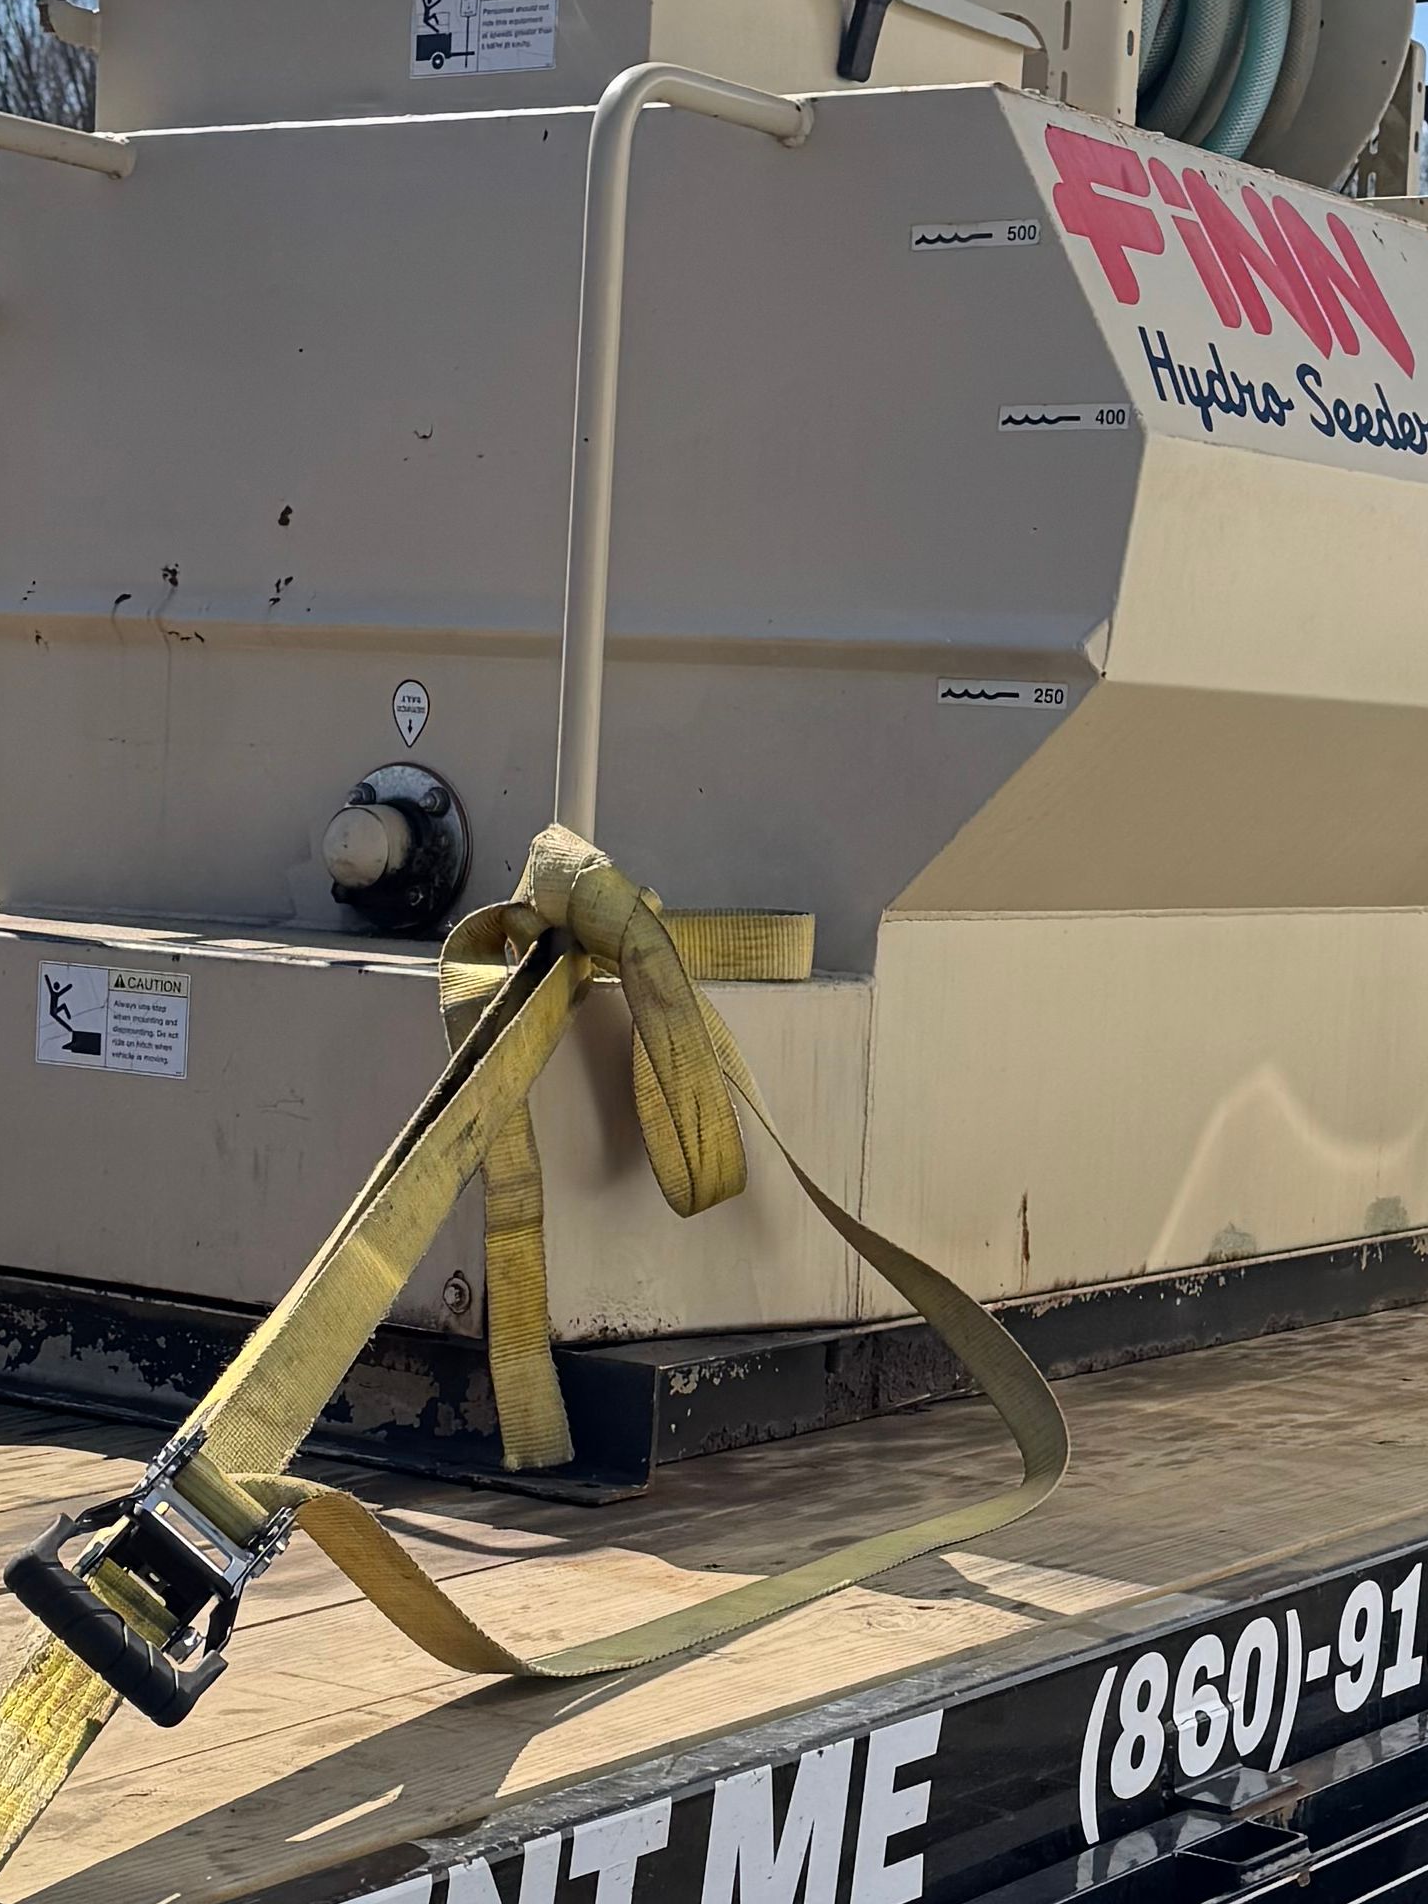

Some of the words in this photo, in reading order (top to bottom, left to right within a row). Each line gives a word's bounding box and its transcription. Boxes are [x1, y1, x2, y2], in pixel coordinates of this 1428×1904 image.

[1006, 223, 1038, 243] 500
[1137, 325, 1293, 433] Hydro
[1094, 407, 1127, 427] 400
[1033, 686, 1065, 706] 250
[127, 976, 182, 993] CAUTION
[113, 999, 137, 1011] Always
[152, 1002, 167, 1014] step
[113, 1013, 131, 1022] when
[132, 1014, 164, 1027] mounting
[165, 1017, 178, 1027] and
